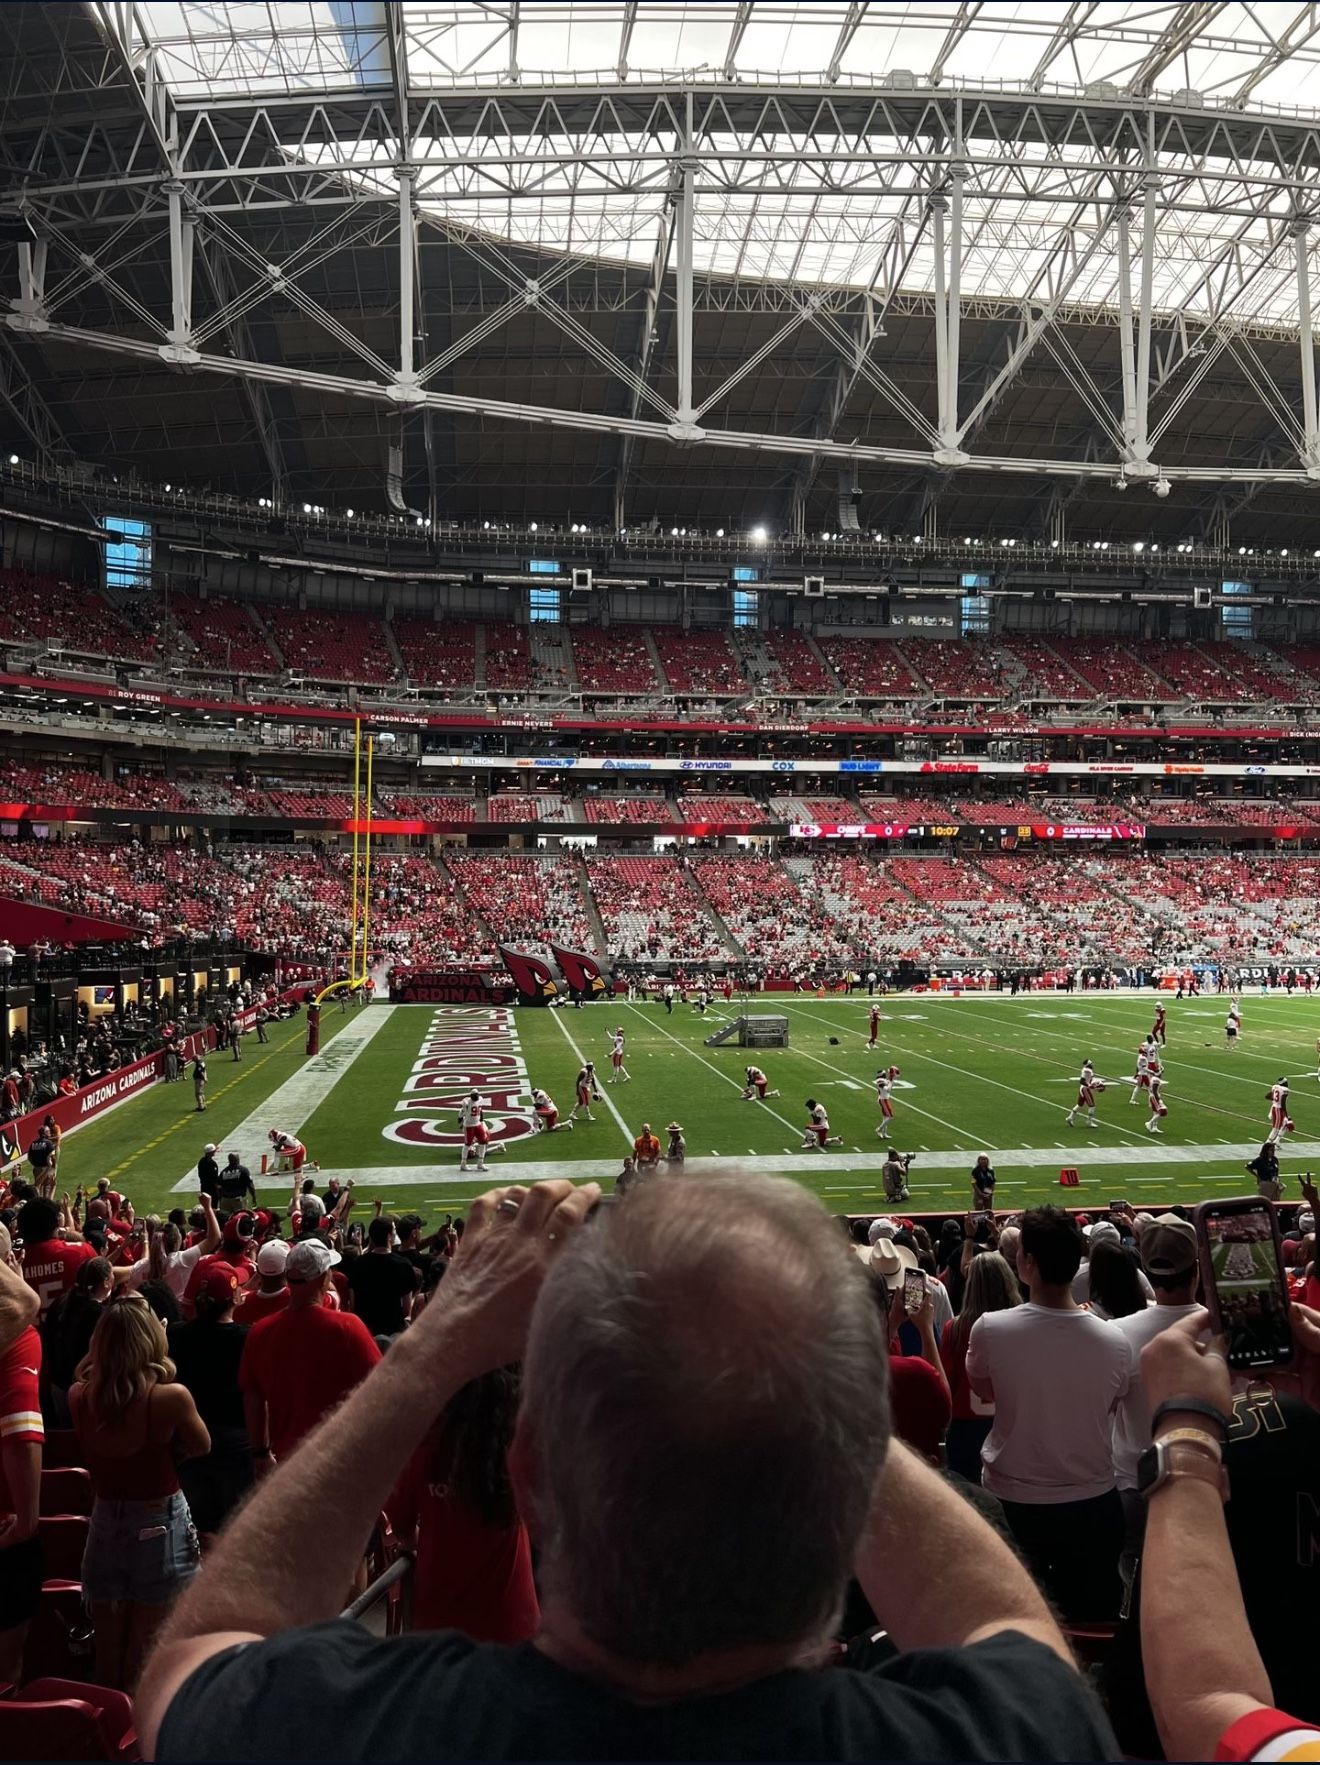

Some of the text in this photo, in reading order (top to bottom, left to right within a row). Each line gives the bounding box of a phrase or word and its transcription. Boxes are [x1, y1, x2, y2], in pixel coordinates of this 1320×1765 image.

[118, 690, 134, 699] ROY
[135, 693, 161, 702] GREEN
[370, 714, 399, 722] CARSON
[400, 716, 429, 724] PALMER
[772, 762, 795, 770] COX
[935, 763, 979, 773] State Farm
[884, 826, 893, 836] 0
[930, 826, 960, 836] 10:07
[1046, 826, 1113, 836] 0 CARDINALS
[411, 974, 482, 987] ARIZONA
[403, 987, 505, 1002] ARDINALS
[382, 1007, 542, 1147] CARDINALS
[80, 1061, 156, 1114] ARIZONA CARDINALS
[1065, 1169, 1080, 1185] 10
[25, 1260, 65, 1280] AHOMES
